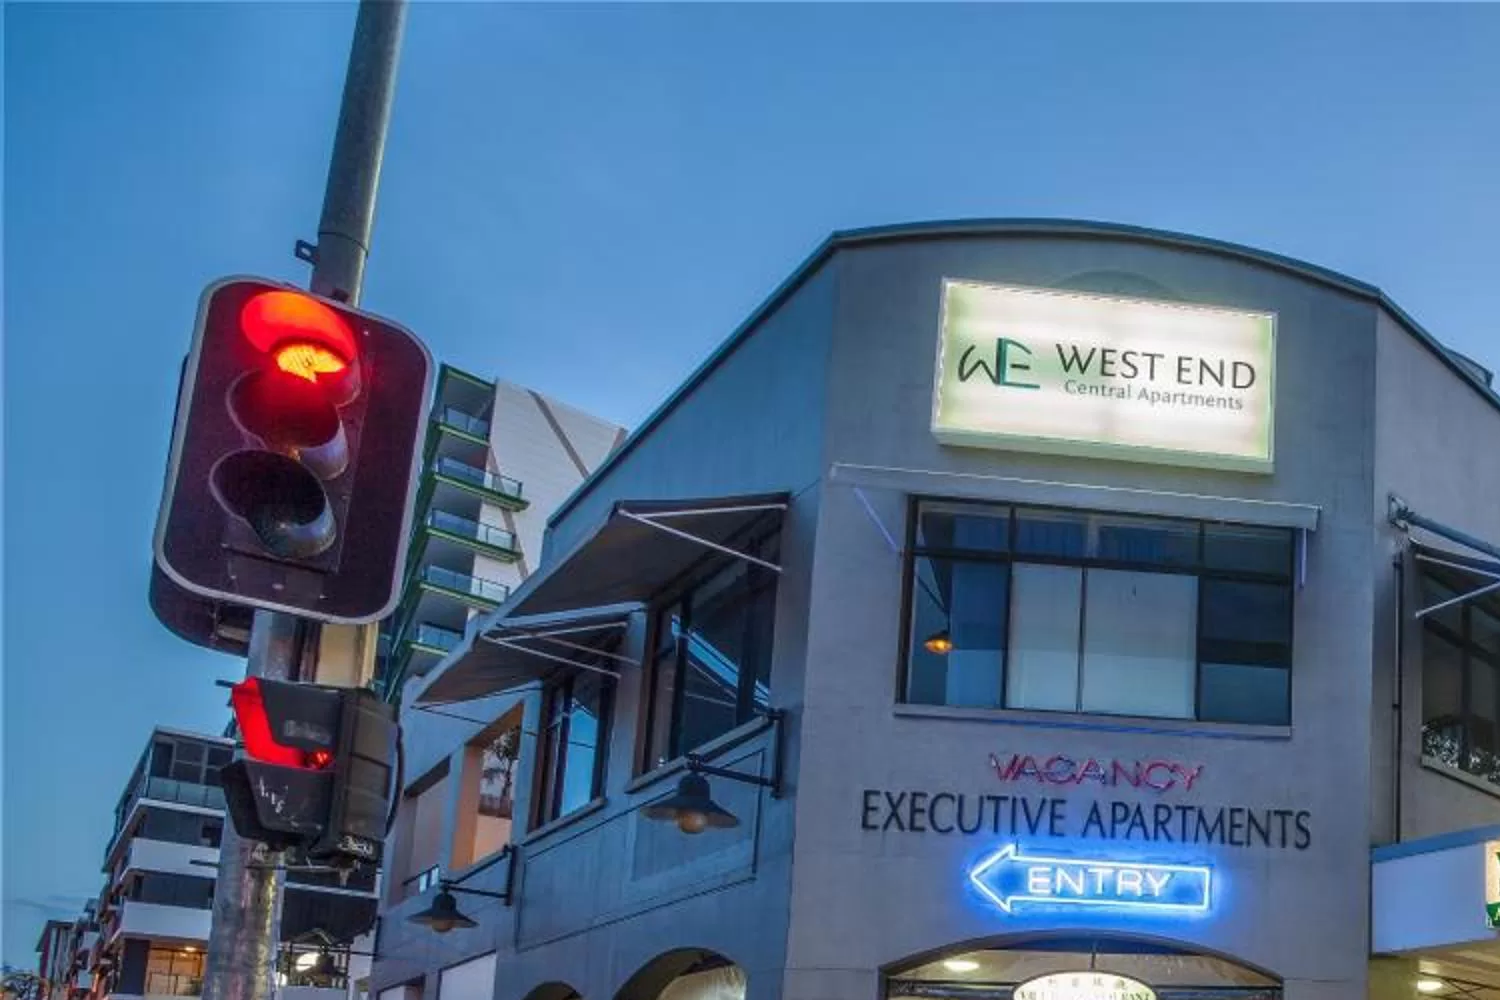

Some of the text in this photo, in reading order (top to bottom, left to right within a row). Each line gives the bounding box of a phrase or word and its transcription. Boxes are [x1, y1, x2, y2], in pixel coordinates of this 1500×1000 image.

[1055, 343, 1257, 390] WEST END
[1064, 379, 1244, 411] Central Apartments
[990, 752, 1203, 792] VACANCY
[861, 790, 1312, 850] EXECUTIVE APARTMENTS
[1027, 866, 1171, 898] ENTRY
